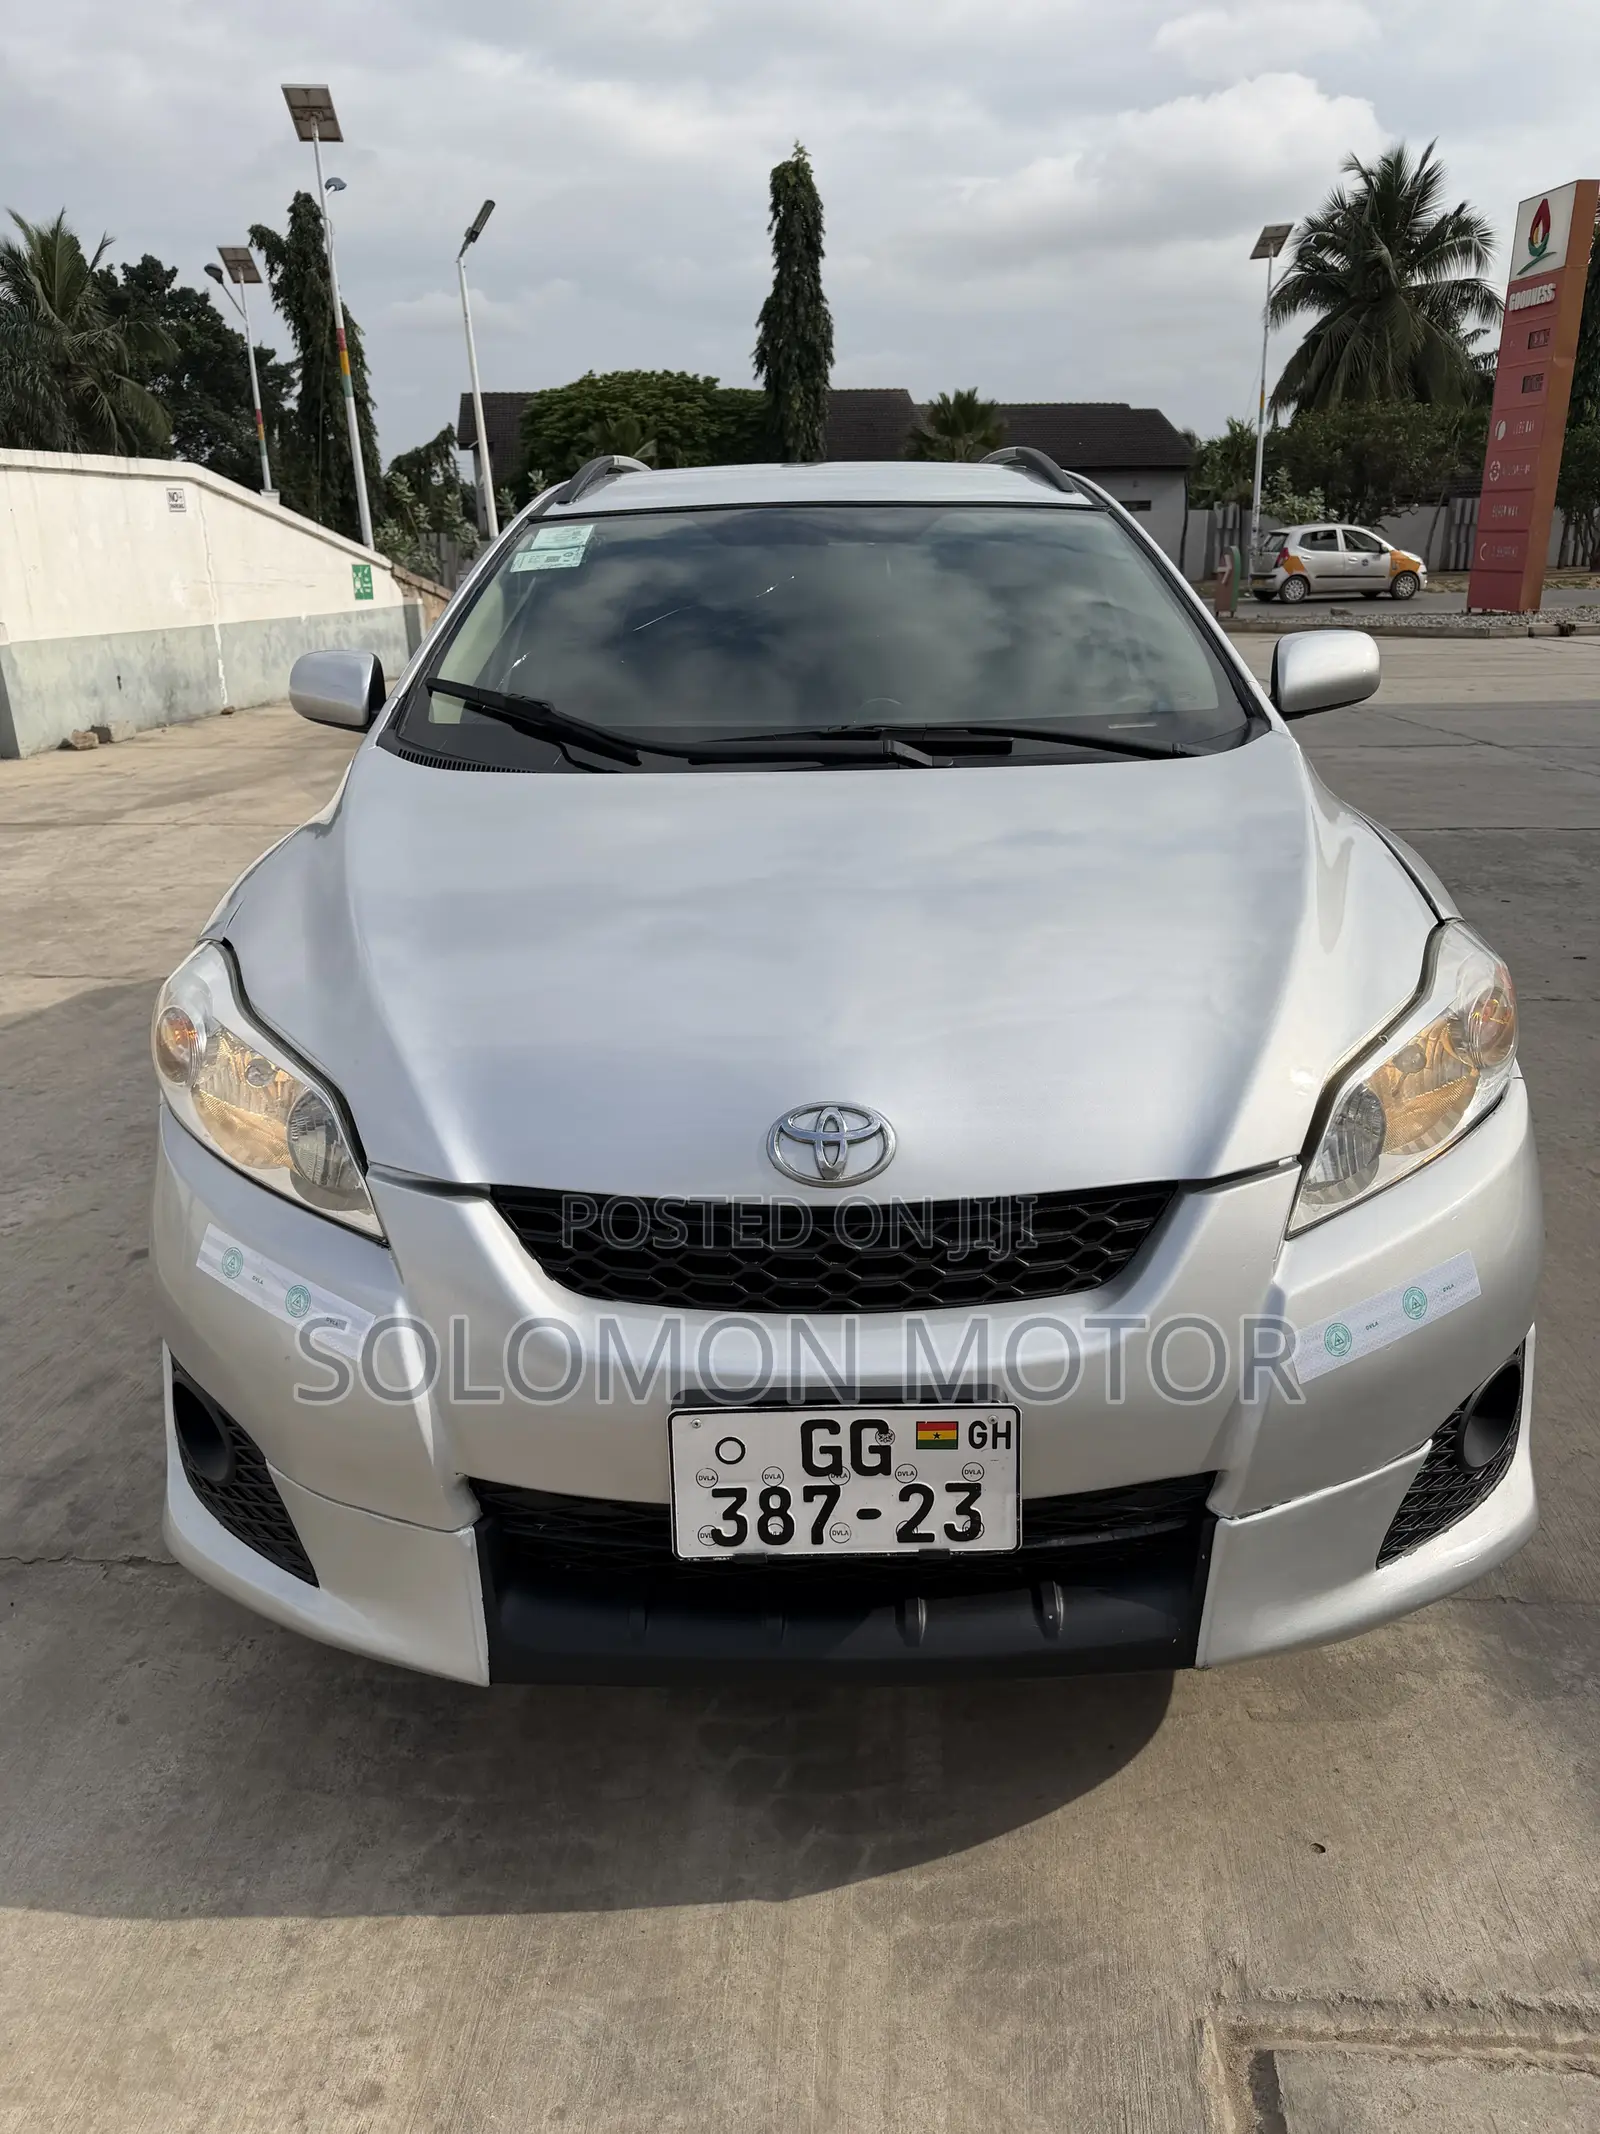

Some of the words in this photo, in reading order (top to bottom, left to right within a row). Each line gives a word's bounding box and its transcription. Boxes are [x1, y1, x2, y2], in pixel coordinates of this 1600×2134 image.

[1509, 283, 1556, 311] GOODNESS
[168, 491, 178, 502] NO
[800, 1419, 892, 1477] GG
[968, 1420, 1012, 1450] GH
[711, 1482, 982, 1547] 387-23
